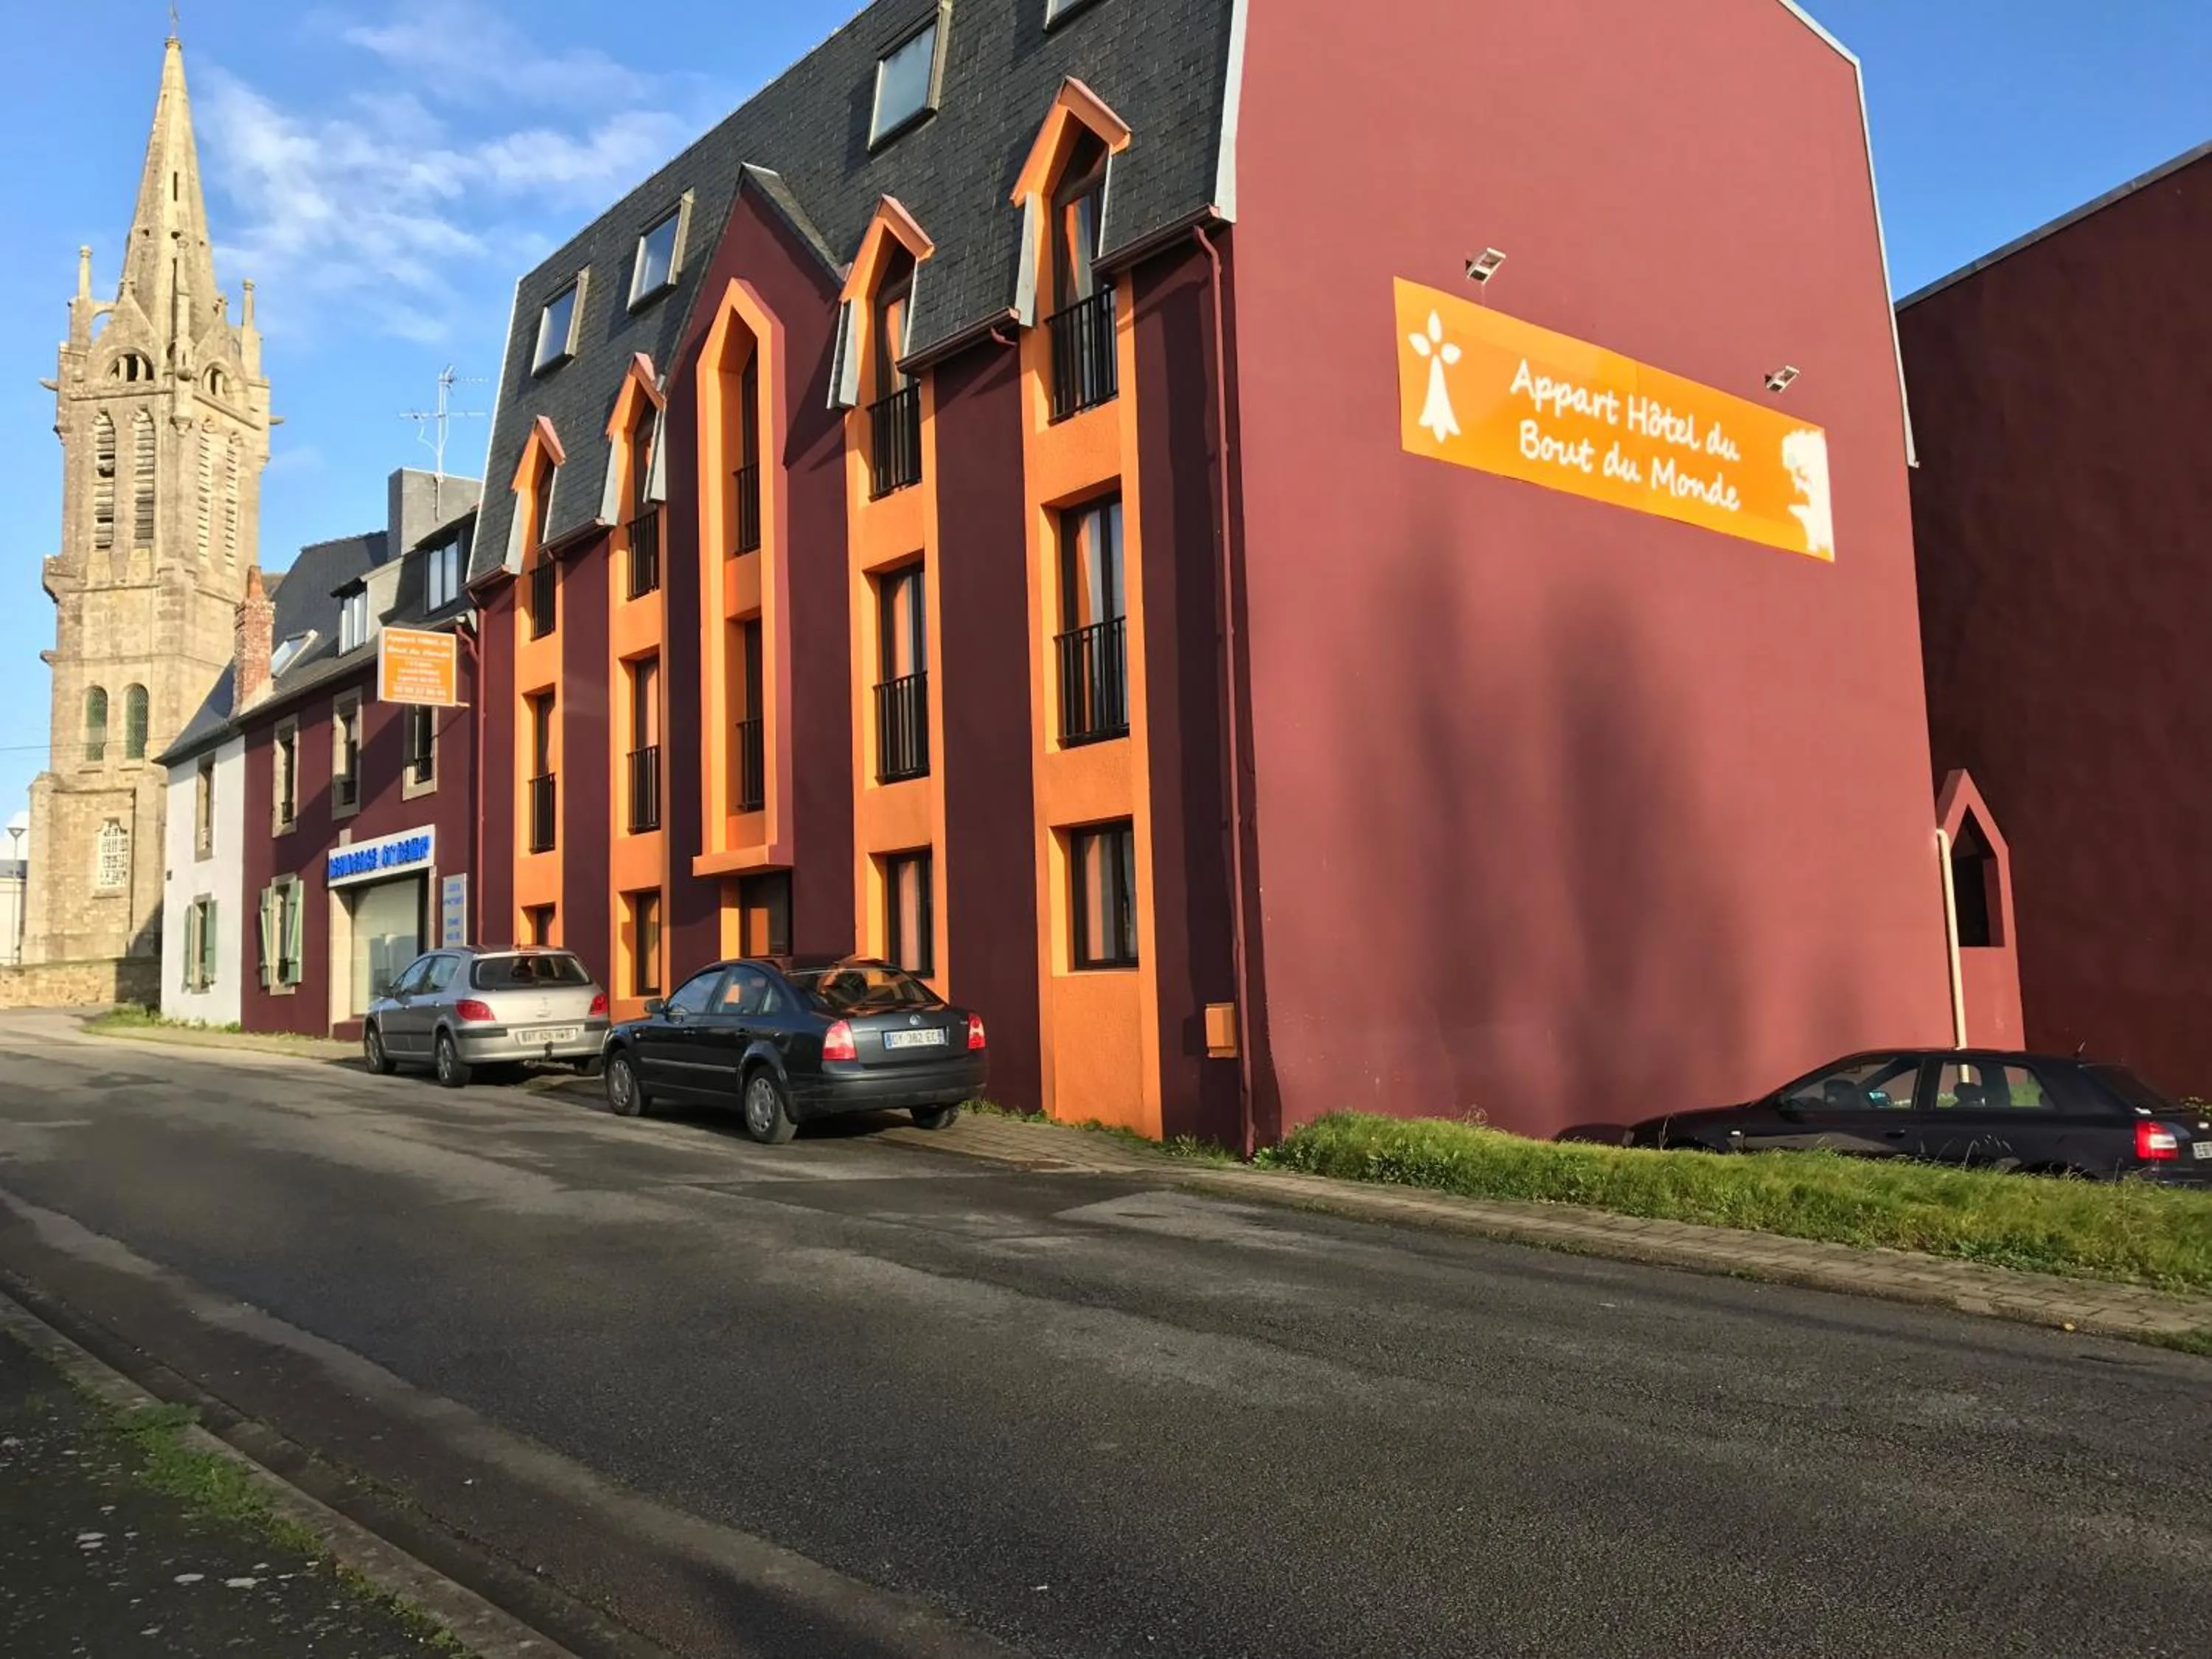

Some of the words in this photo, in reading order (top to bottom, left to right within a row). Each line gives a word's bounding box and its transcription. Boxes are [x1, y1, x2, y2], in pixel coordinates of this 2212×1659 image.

[1509, 359, 1620, 423] Appart
[1628, 394, 1700, 449] Hôtel
[1707, 421, 1740, 461] du
[1520, 420, 1594, 473] Bout
[1604, 440, 1641, 481] du
[1651, 456, 1740, 510] Monde
